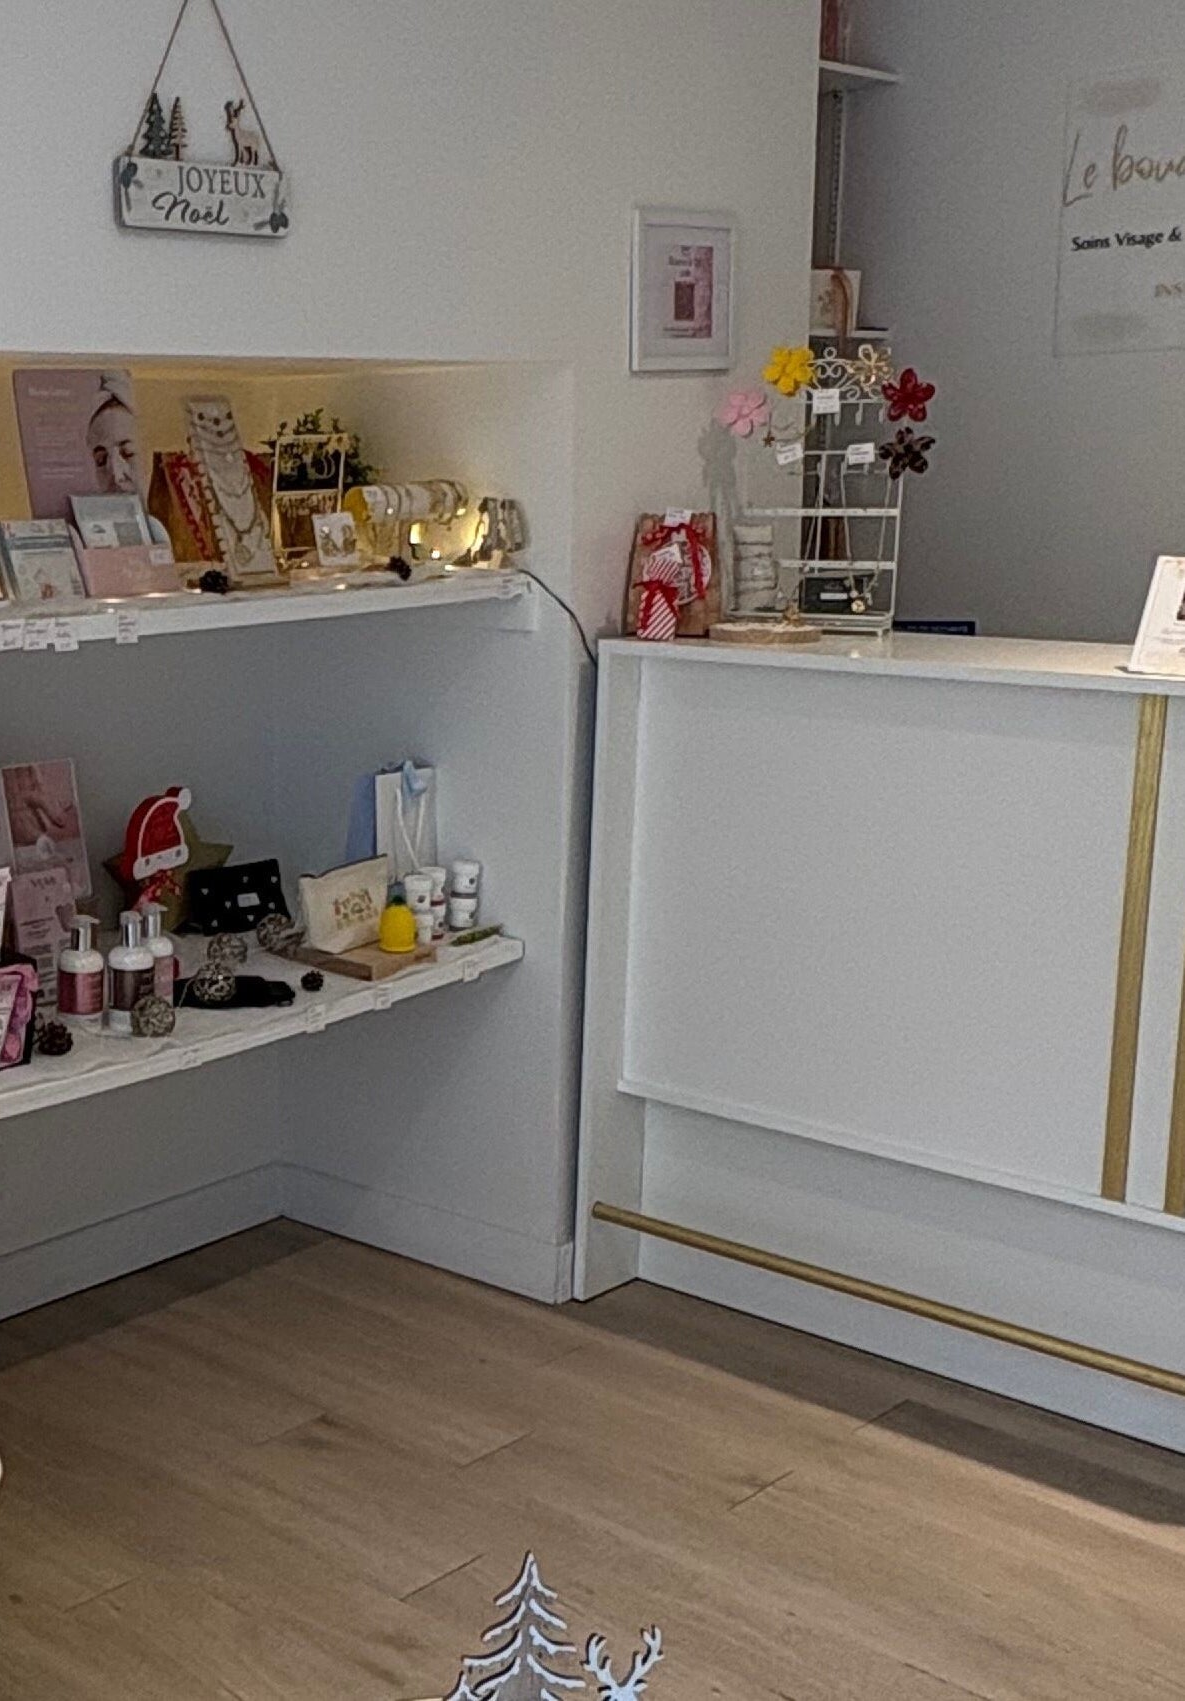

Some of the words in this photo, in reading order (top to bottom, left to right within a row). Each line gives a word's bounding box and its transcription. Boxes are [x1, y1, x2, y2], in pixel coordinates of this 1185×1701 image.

[178, 166, 265, 199] JOYEUX
[1062, 131, 1096, 208] Le
[151, 192, 230, 226] Noël
[1071, 235, 1111, 251] Soins
[1115, 231, 1165, 249] Visage
[1168, 226, 1183, 242] &
